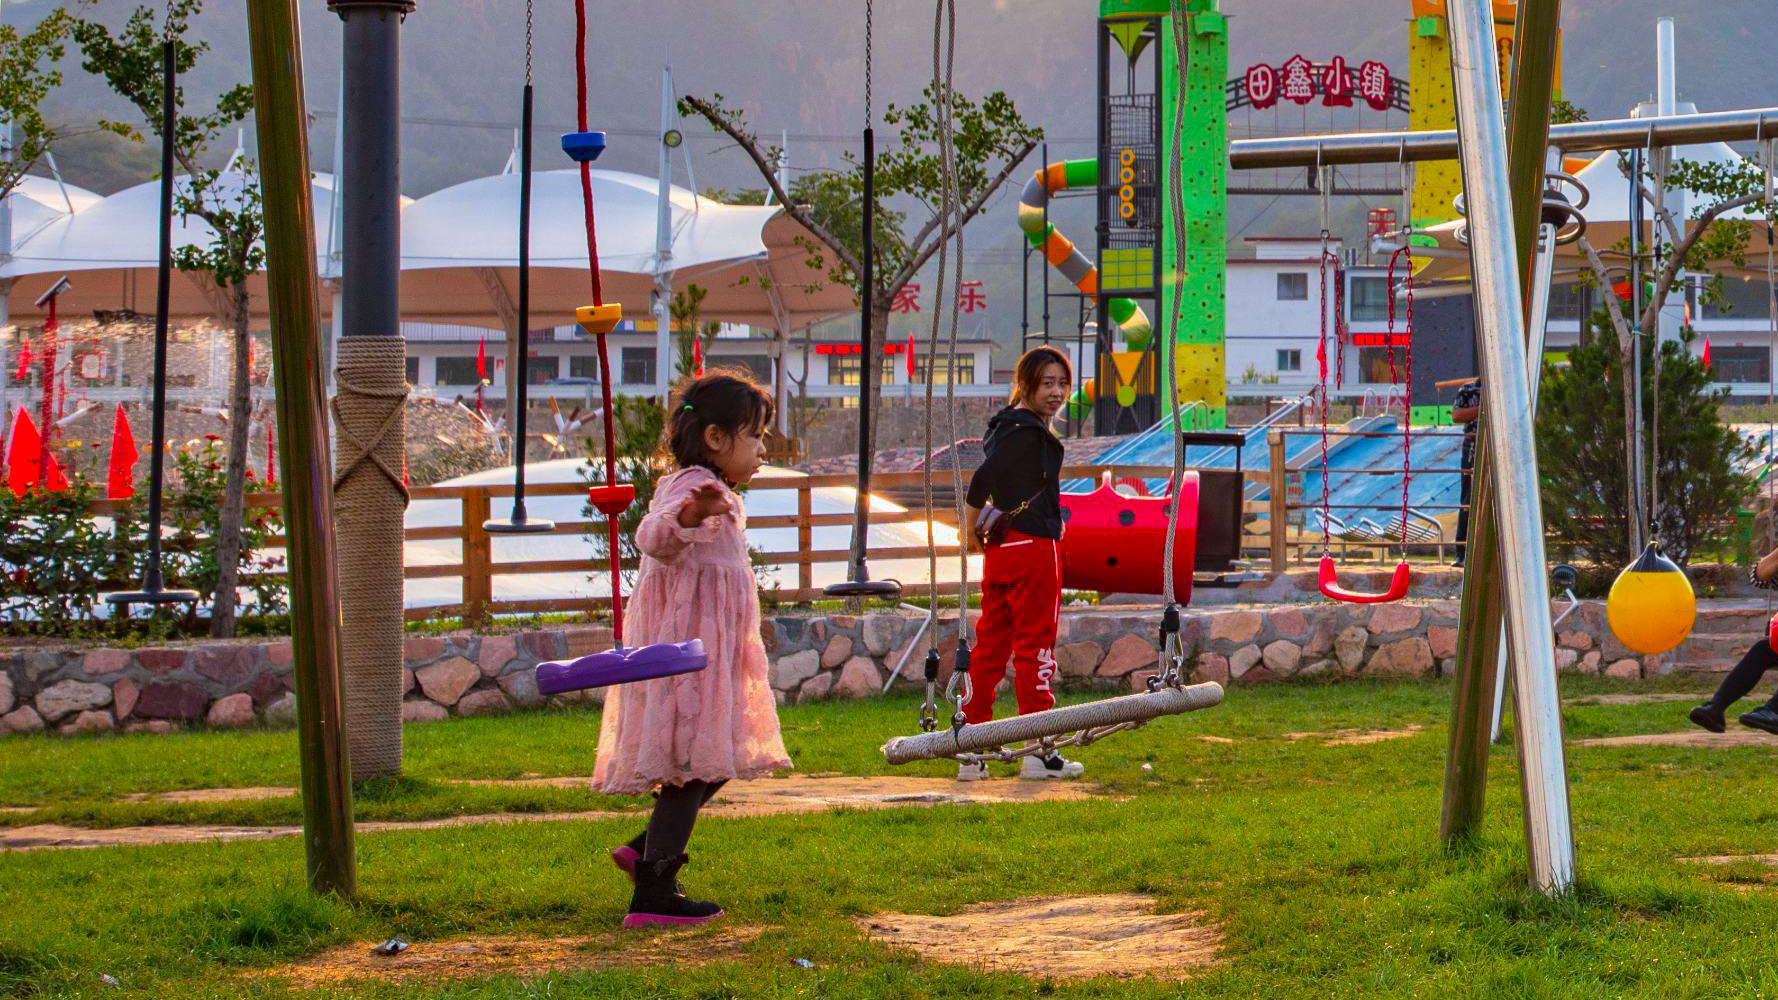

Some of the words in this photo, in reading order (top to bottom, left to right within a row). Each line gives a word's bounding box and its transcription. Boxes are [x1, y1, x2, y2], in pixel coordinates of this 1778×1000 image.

[1248, 56, 1387, 103] 田鑫小镇
[1035, 647, 1054, 691] LOVE
